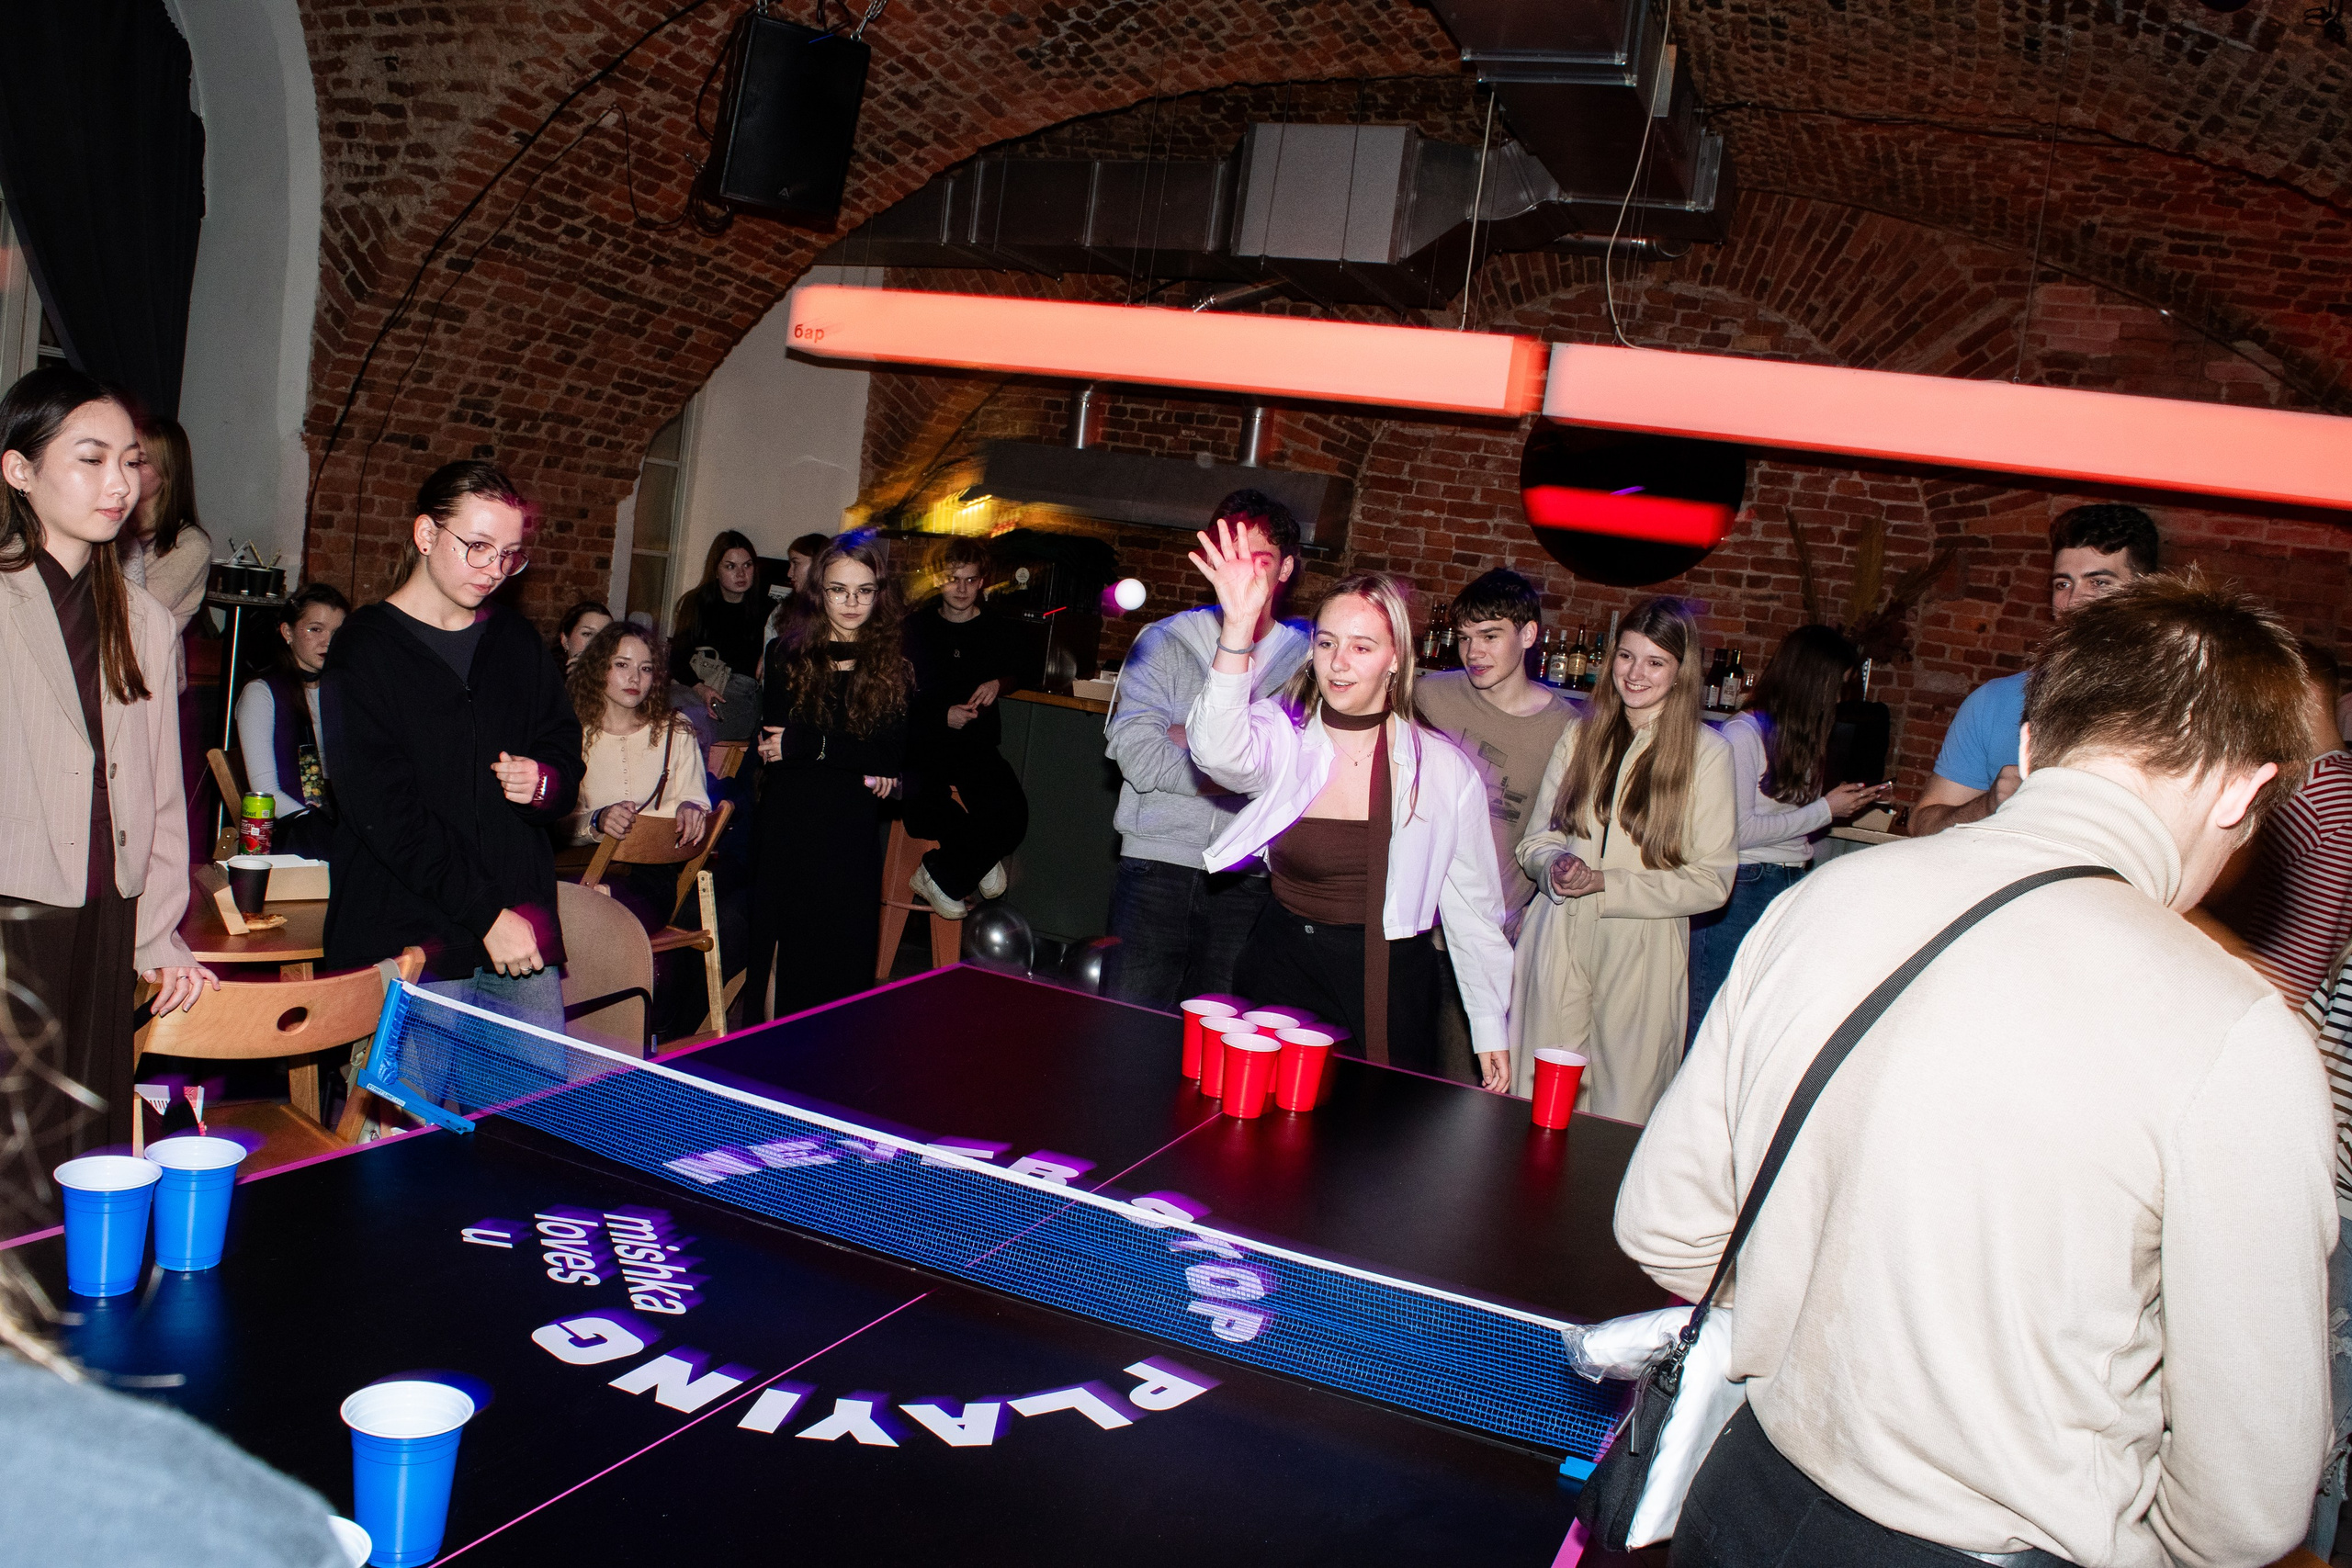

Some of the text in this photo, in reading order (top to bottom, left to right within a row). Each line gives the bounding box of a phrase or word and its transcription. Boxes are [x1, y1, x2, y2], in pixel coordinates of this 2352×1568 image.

[794, 324, 824, 343] бар
[460, 1227, 514, 1249] u
[534, 1213, 601, 1286] loves
[603, 1213, 695, 1315] mishka
[531, 1317, 1208, 1448] PLAYING
